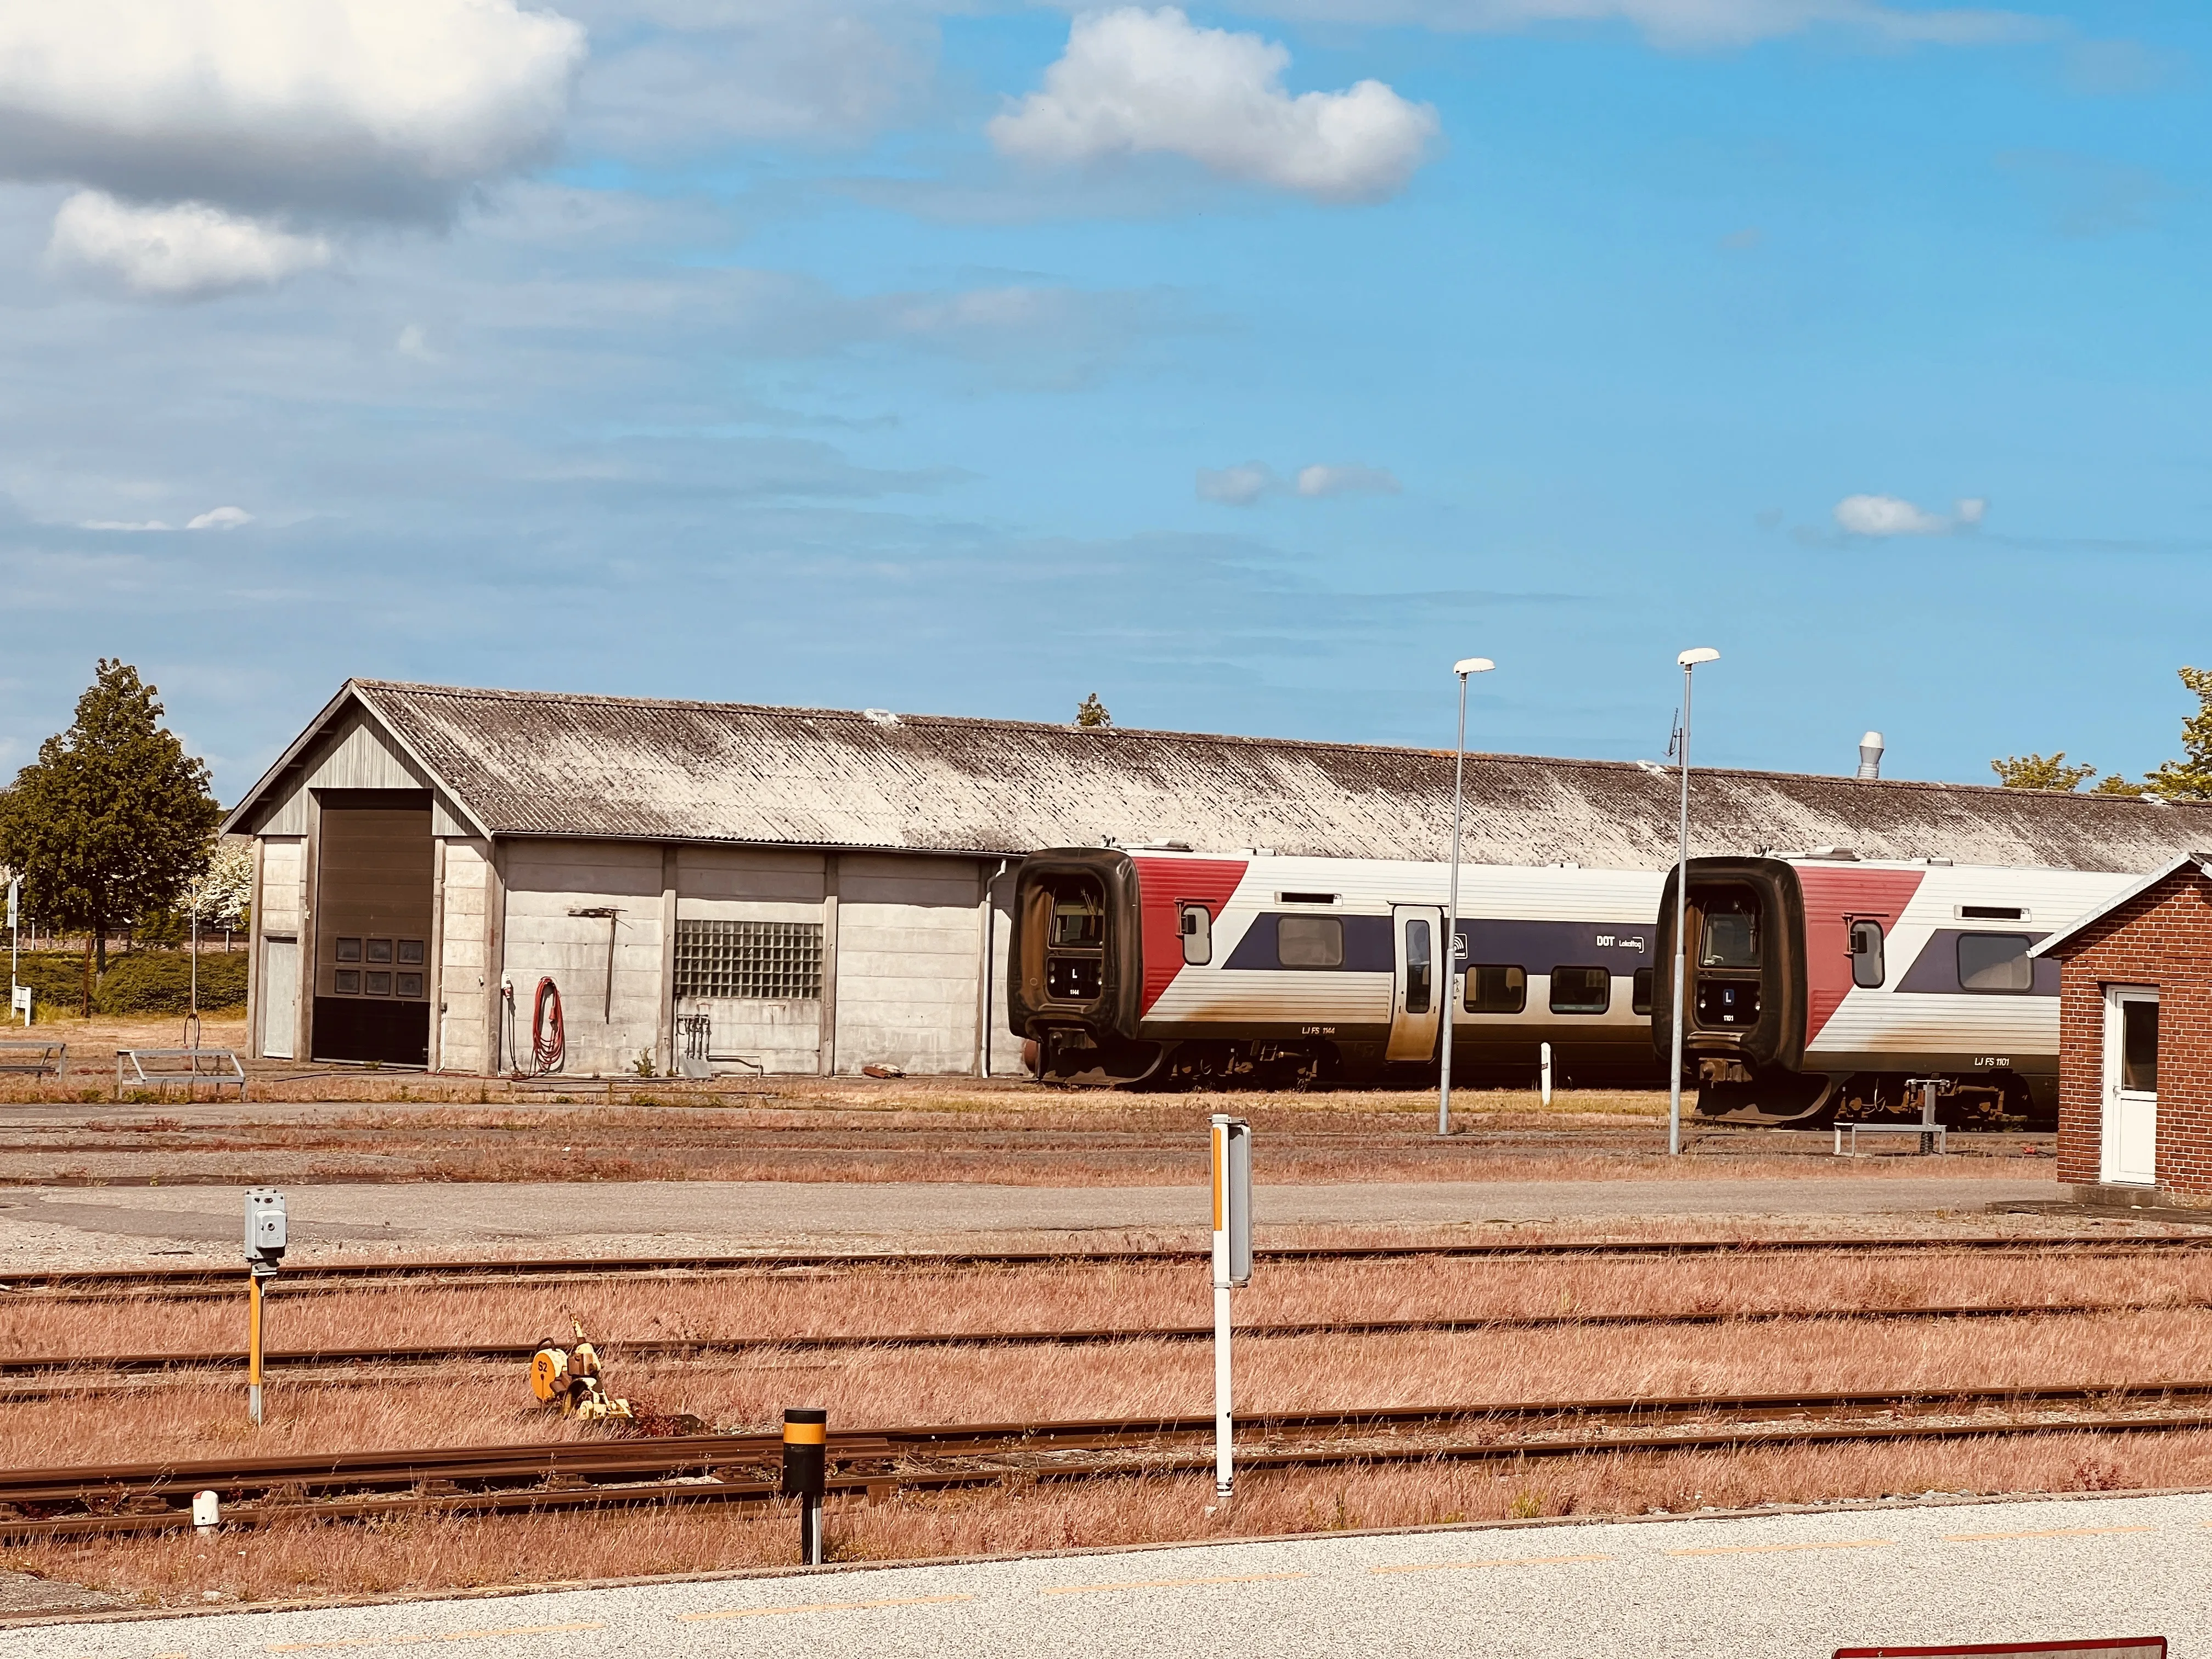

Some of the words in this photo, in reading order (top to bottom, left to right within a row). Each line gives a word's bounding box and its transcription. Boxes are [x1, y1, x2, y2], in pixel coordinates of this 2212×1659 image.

[1596, 935, 1615, 946] DOT
[1072, 968, 1077, 979] L
[1725, 992, 1731, 1003] L
[1311, 1026, 1320, 1035] FS
[1974, 1057, 1984, 1065] LJ
[1985, 1057, 1994, 1066] FS
[1996, 1058, 2010, 1066] 1101
[538, 1360, 548, 1373] S2
